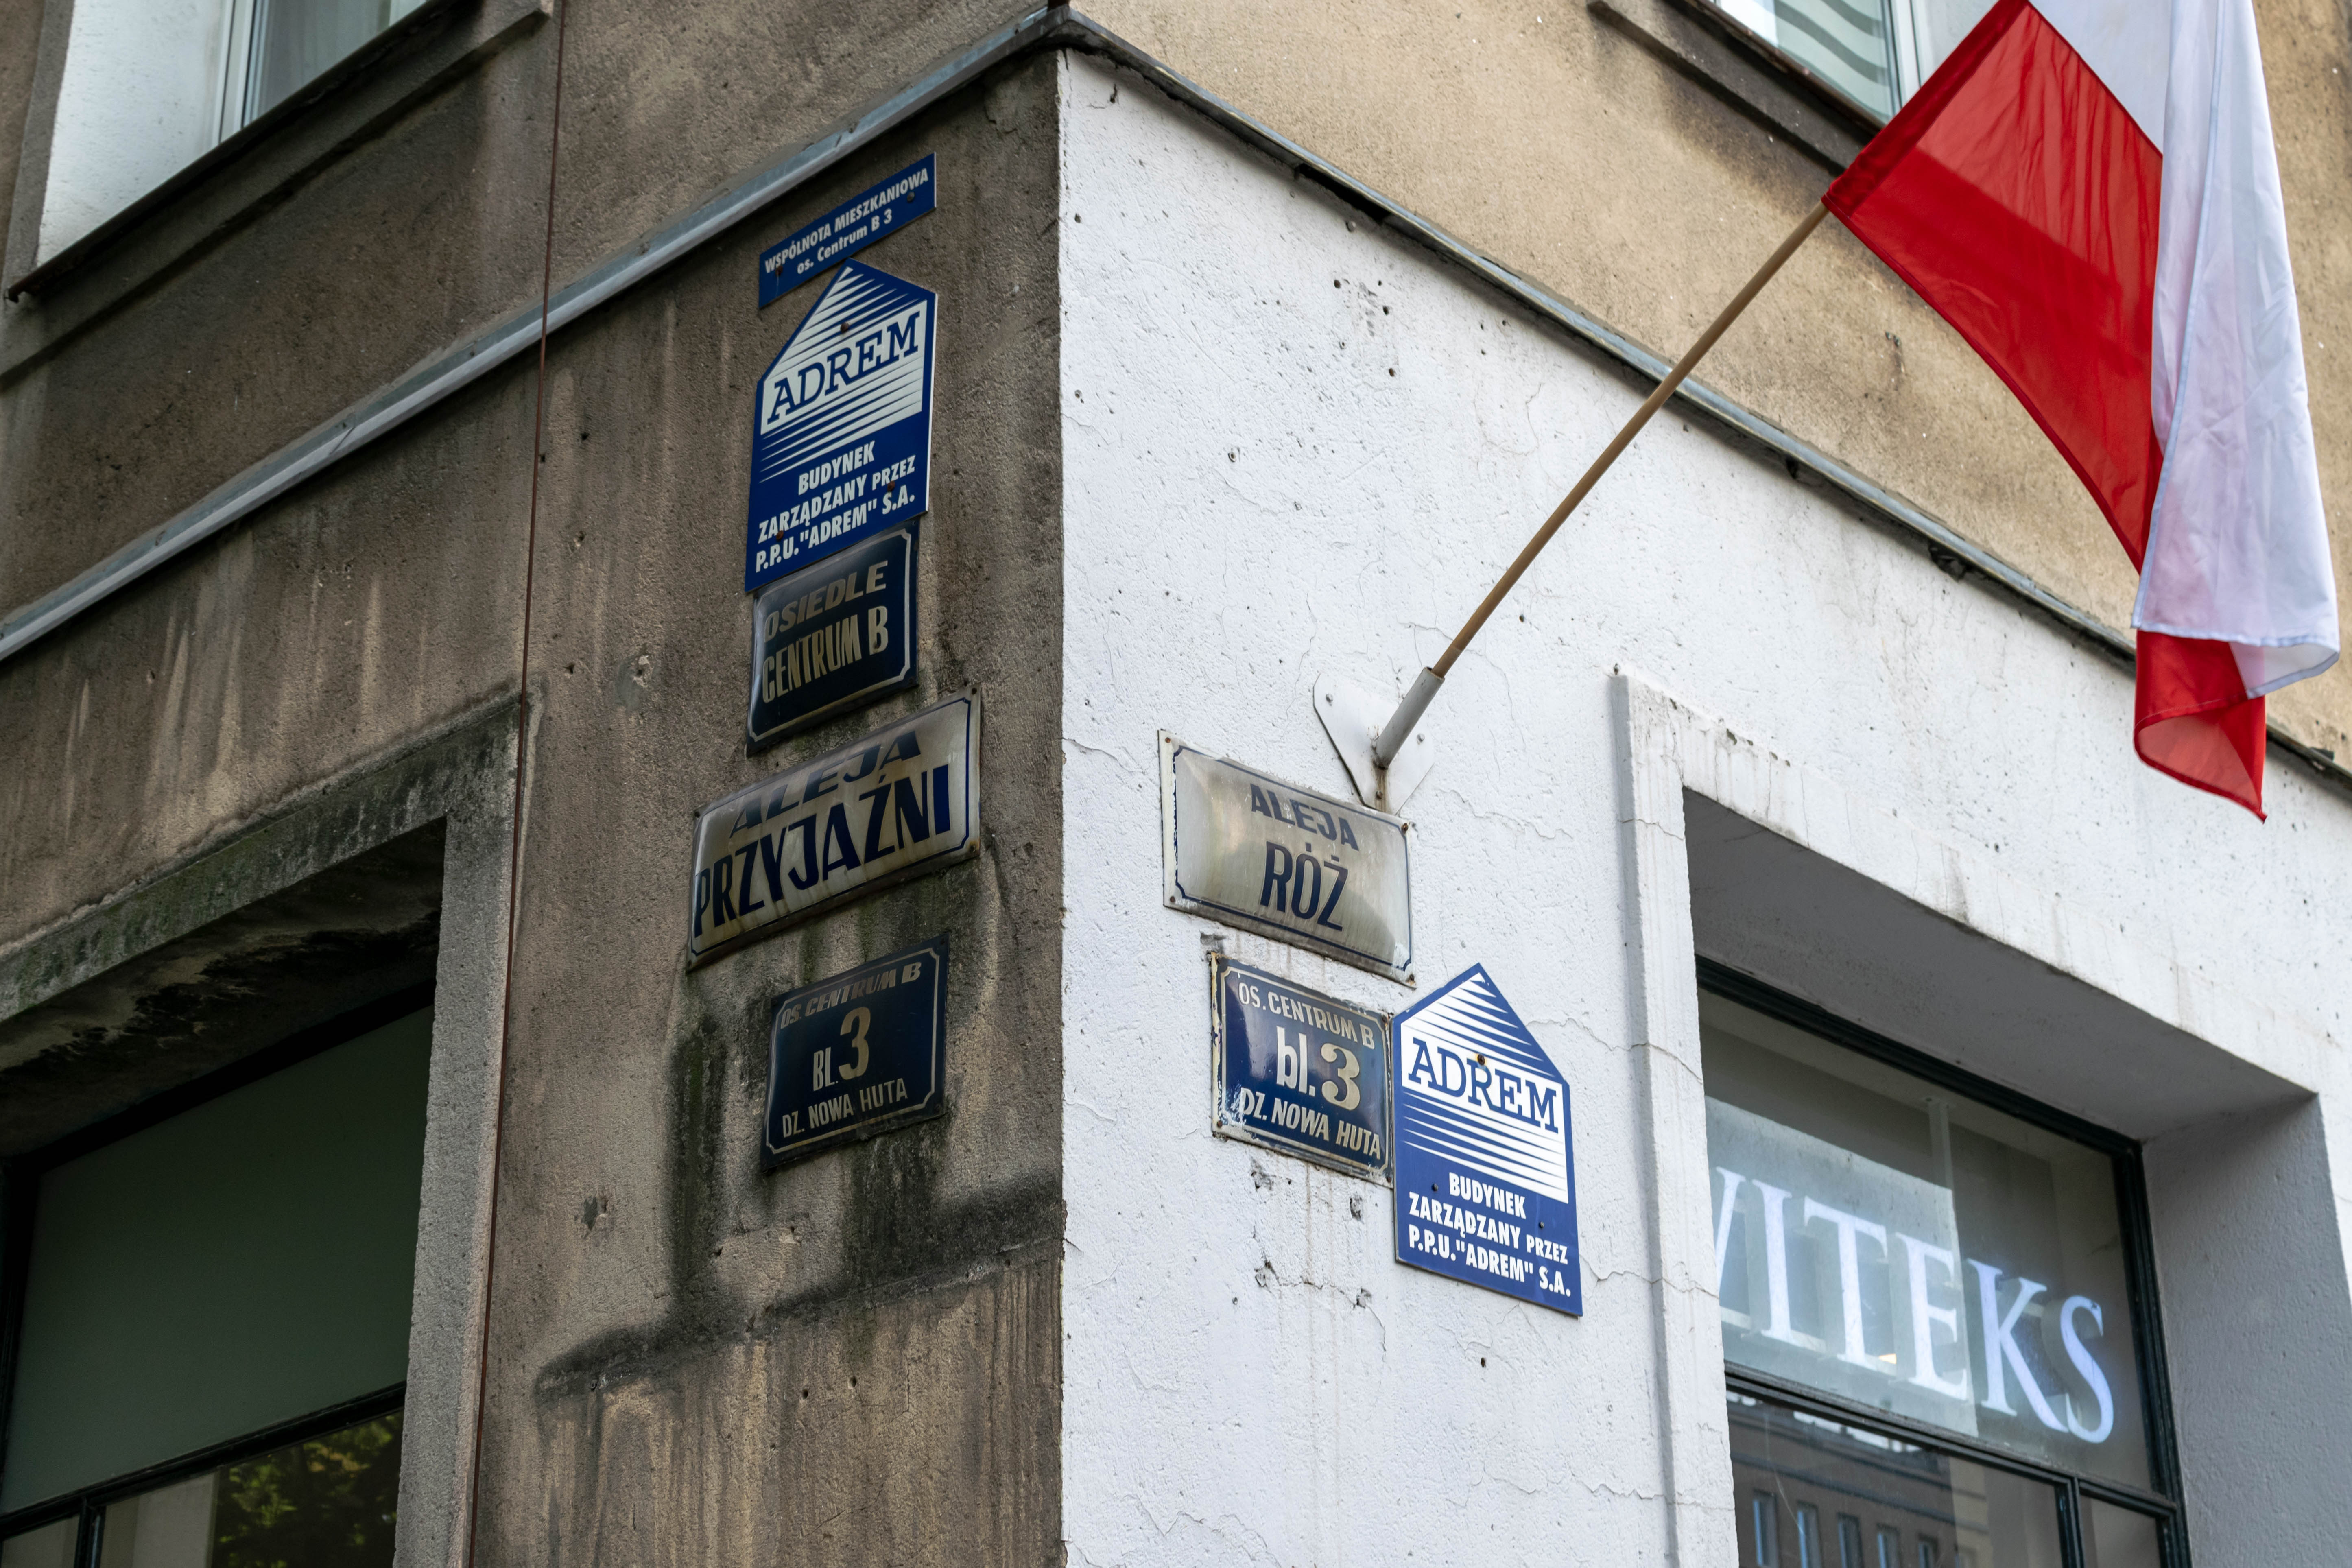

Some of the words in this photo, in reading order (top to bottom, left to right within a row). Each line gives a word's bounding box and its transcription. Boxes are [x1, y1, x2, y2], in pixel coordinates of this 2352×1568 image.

[765, 223, 831, 274] WSPÓLNOTA
[834, 168, 929, 233] MIESZKANIOWA
[797, 258, 814, 274] os.
[817, 227, 868, 262] Centrum
[871, 216, 880, 231] B
[884, 208, 892, 224] 3
[767, 310, 920, 425] ADREM
[758, 474, 867, 544] ZARZĄDZANY
[872, 454, 916, 491] PRZEZ
[798, 440, 875, 496] BUDYNEK
[756, 537, 799, 573] P.P.U.
[800, 498, 878, 548] "ADREM"
[882, 484, 915, 515] S.A.
[764, 560, 888, 642] OSIEDLE
[762, 614, 862, 703] CENTRUM
[868, 605, 889, 655] B
[730, 731, 921, 839] ALEJA
[1250, 784, 1360, 851] ALEJA
[694, 764, 951, 938] PRZYJAŹNI
[1260, 841, 1349, 932] RÓŻ
[805, 969, 897, 1017] CENTRUM
[902, 962, 922, 983] B
[1238, 982, 1266, 1010] OS.
[1268, 991, 1358, 1043] CENTRUM
[1360, 1023, 1375, 1050] B
[838, 1007, 871, 1080] 3
[1276, 1026, 1315, 1097] bl.
[1321, 1043, 1360, 1111] 3
[782, 1111, 805, 1138] DZ.
[808, 1094, 854, 1129] NOWA
[859, 1078, 908, 1112] HUTA
[1240, 1087, 1267, 1121] DZ.
[1271, 1097, 1329, 1140] NOWA
[1335, 1120, 1381, 1159] HUTA
[1408, 1037, 1559, 1134] ADREM
[1409, 1191, 1521, 1249] ZARZĄDZANY
[1526, 1234, 1568, 1265] PRZEZ
[1449, 1172, 1527, 1219] BUDYNEK
[1409, 1224, 1456, 1262] P.P.U.
[1539, 1266, 1571, 1297] S.A.
